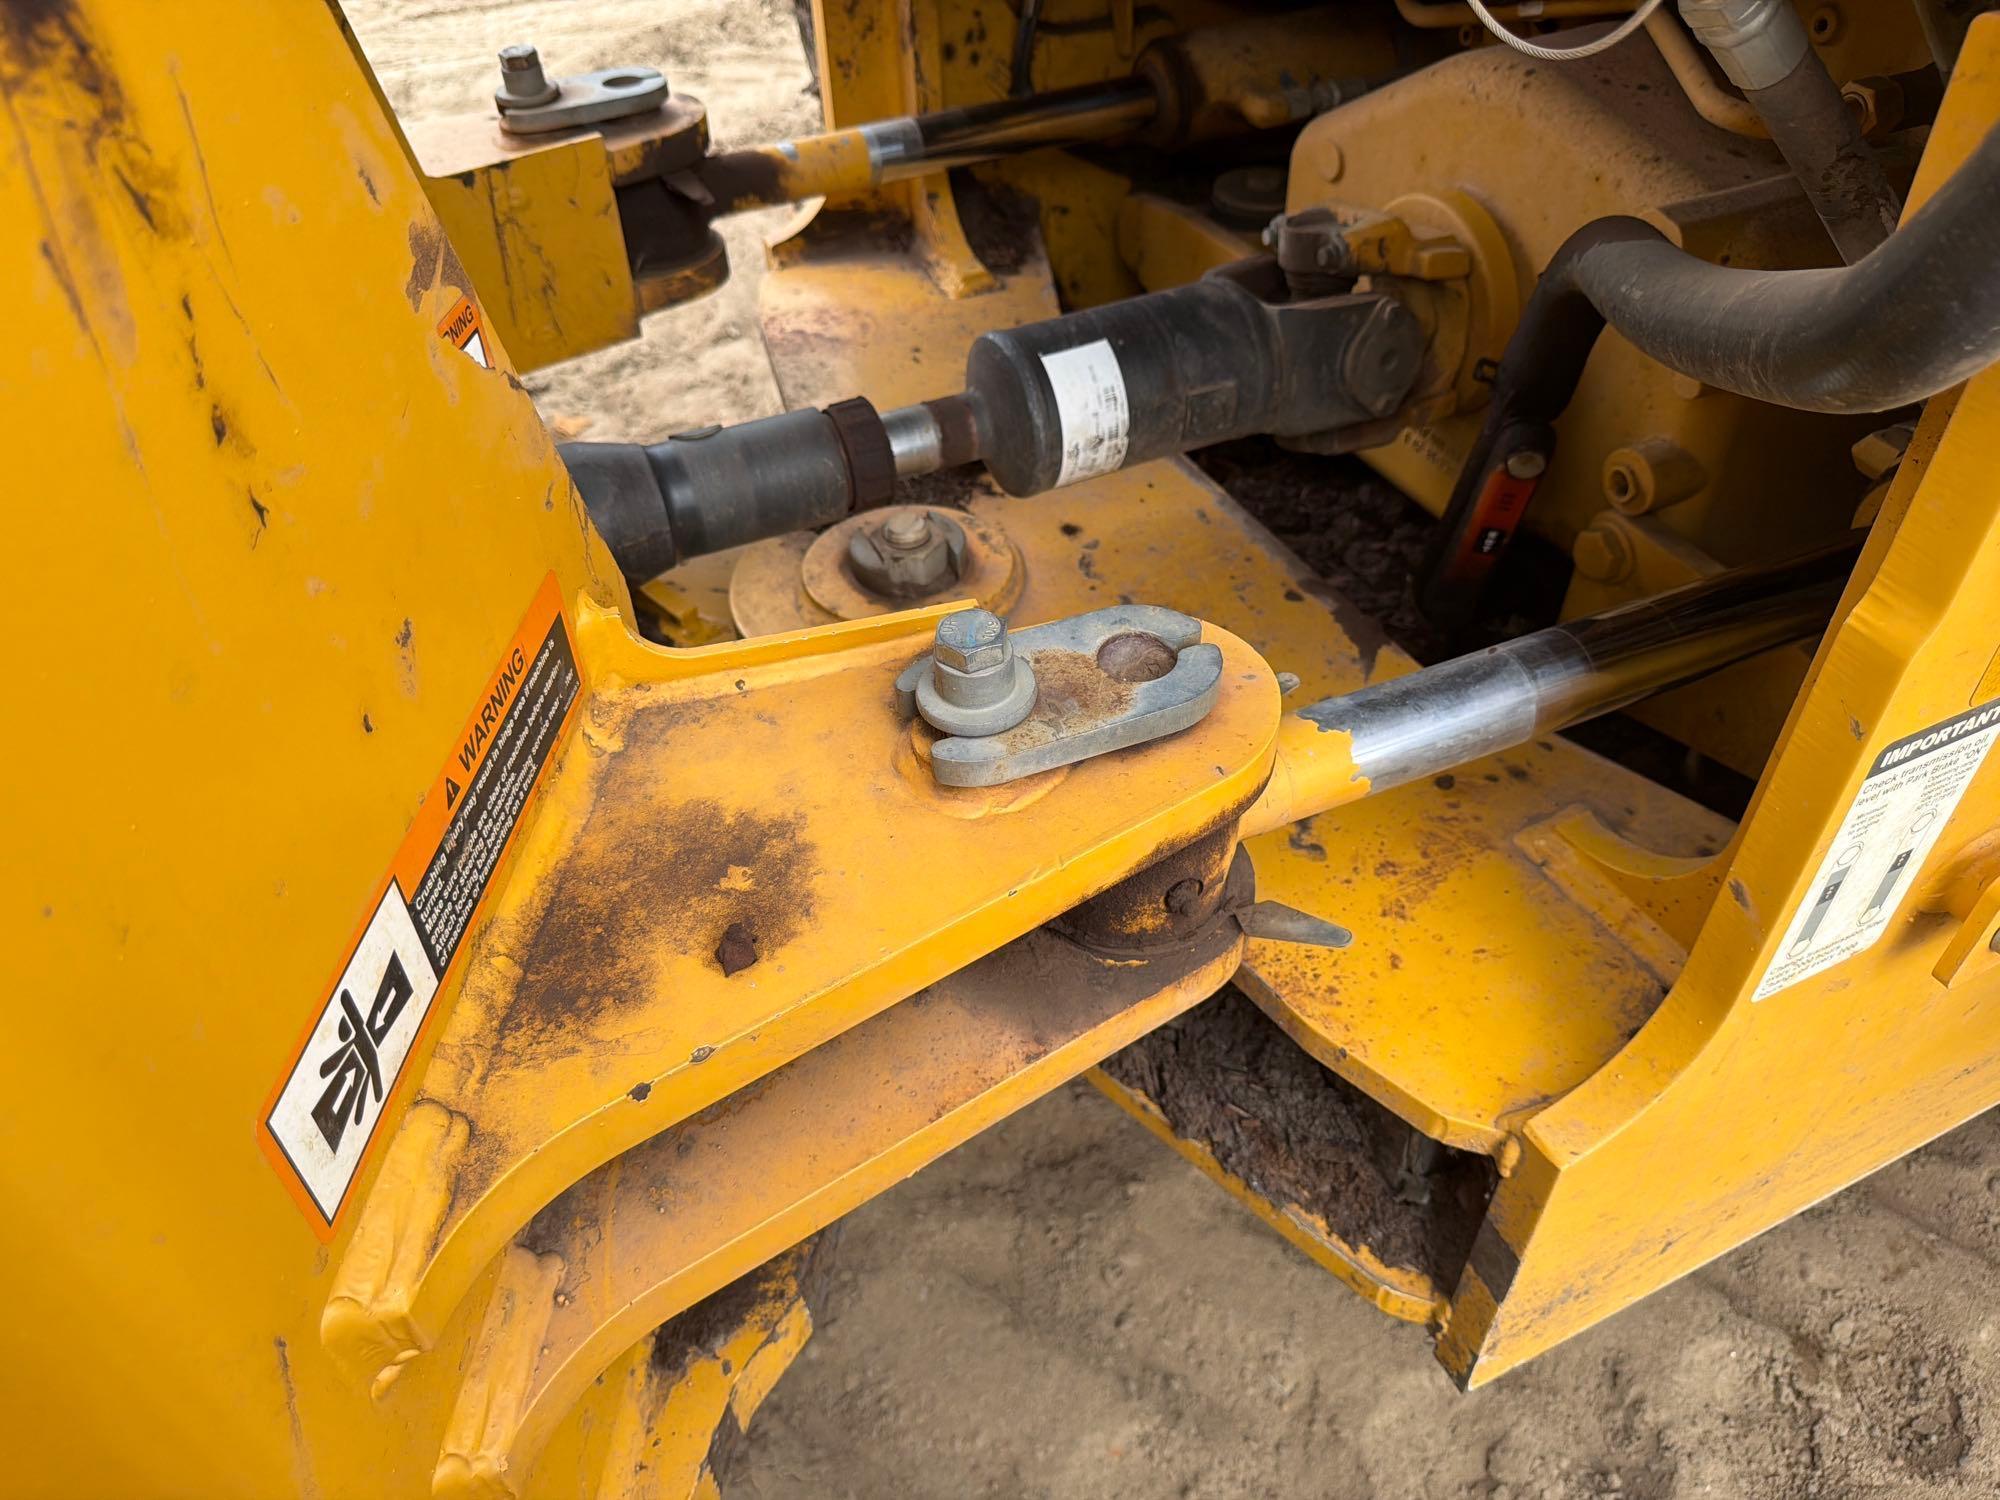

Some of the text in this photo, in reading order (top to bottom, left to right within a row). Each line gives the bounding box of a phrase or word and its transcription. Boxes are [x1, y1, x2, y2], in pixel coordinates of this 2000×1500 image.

[443, 306, 474, 343] NING
[415, 639, 554, 909] Crushing injury may result in hinge area if machine is
[459, 648, 523, 771] WARNING
[1856, 790, 1881, 807] level
[1883, 781, 1903, 795] with
[1905, 770, 1928, 785] Park
[1931, 757, 1960, 775] Brake
[1863, 774, 1898, 794] Check
[1901, 743, 1972, 778] transmission
[1974, 733, 1990, 747] oil
[425, 899, 443, 933] Make
[443, 870, 457, 899] sure
[457, 829, 477, 872] people
[477, 810, 487, 830] are
[487, 780, 500, 809] clear
[500, 765, 507, 782] of
[506, 726, 528, 769] machine
[527, 694, 544, 726] before
[430, 772, 516, 944] engine or steering the machine.
[435, 914, 456, 956] Attach
[454, 868, 478, 913] locking
[476, 846, 487, 869] bar
[486, 811, 505, 848] before
[504, 754, 532, 813] performing
[531, 719, 549, 754] service
[548, 696, 559, 719] near
[440, 948, 447, 966] of
[447, 898, 472, 950] machine
[472, 882, 479, 897] or
[478, 815, 512, 883] transporting
[511, 799, 520, 814] on
[522, 763, 538, 791] truck.
[420, 877, 444, 922] turned.
